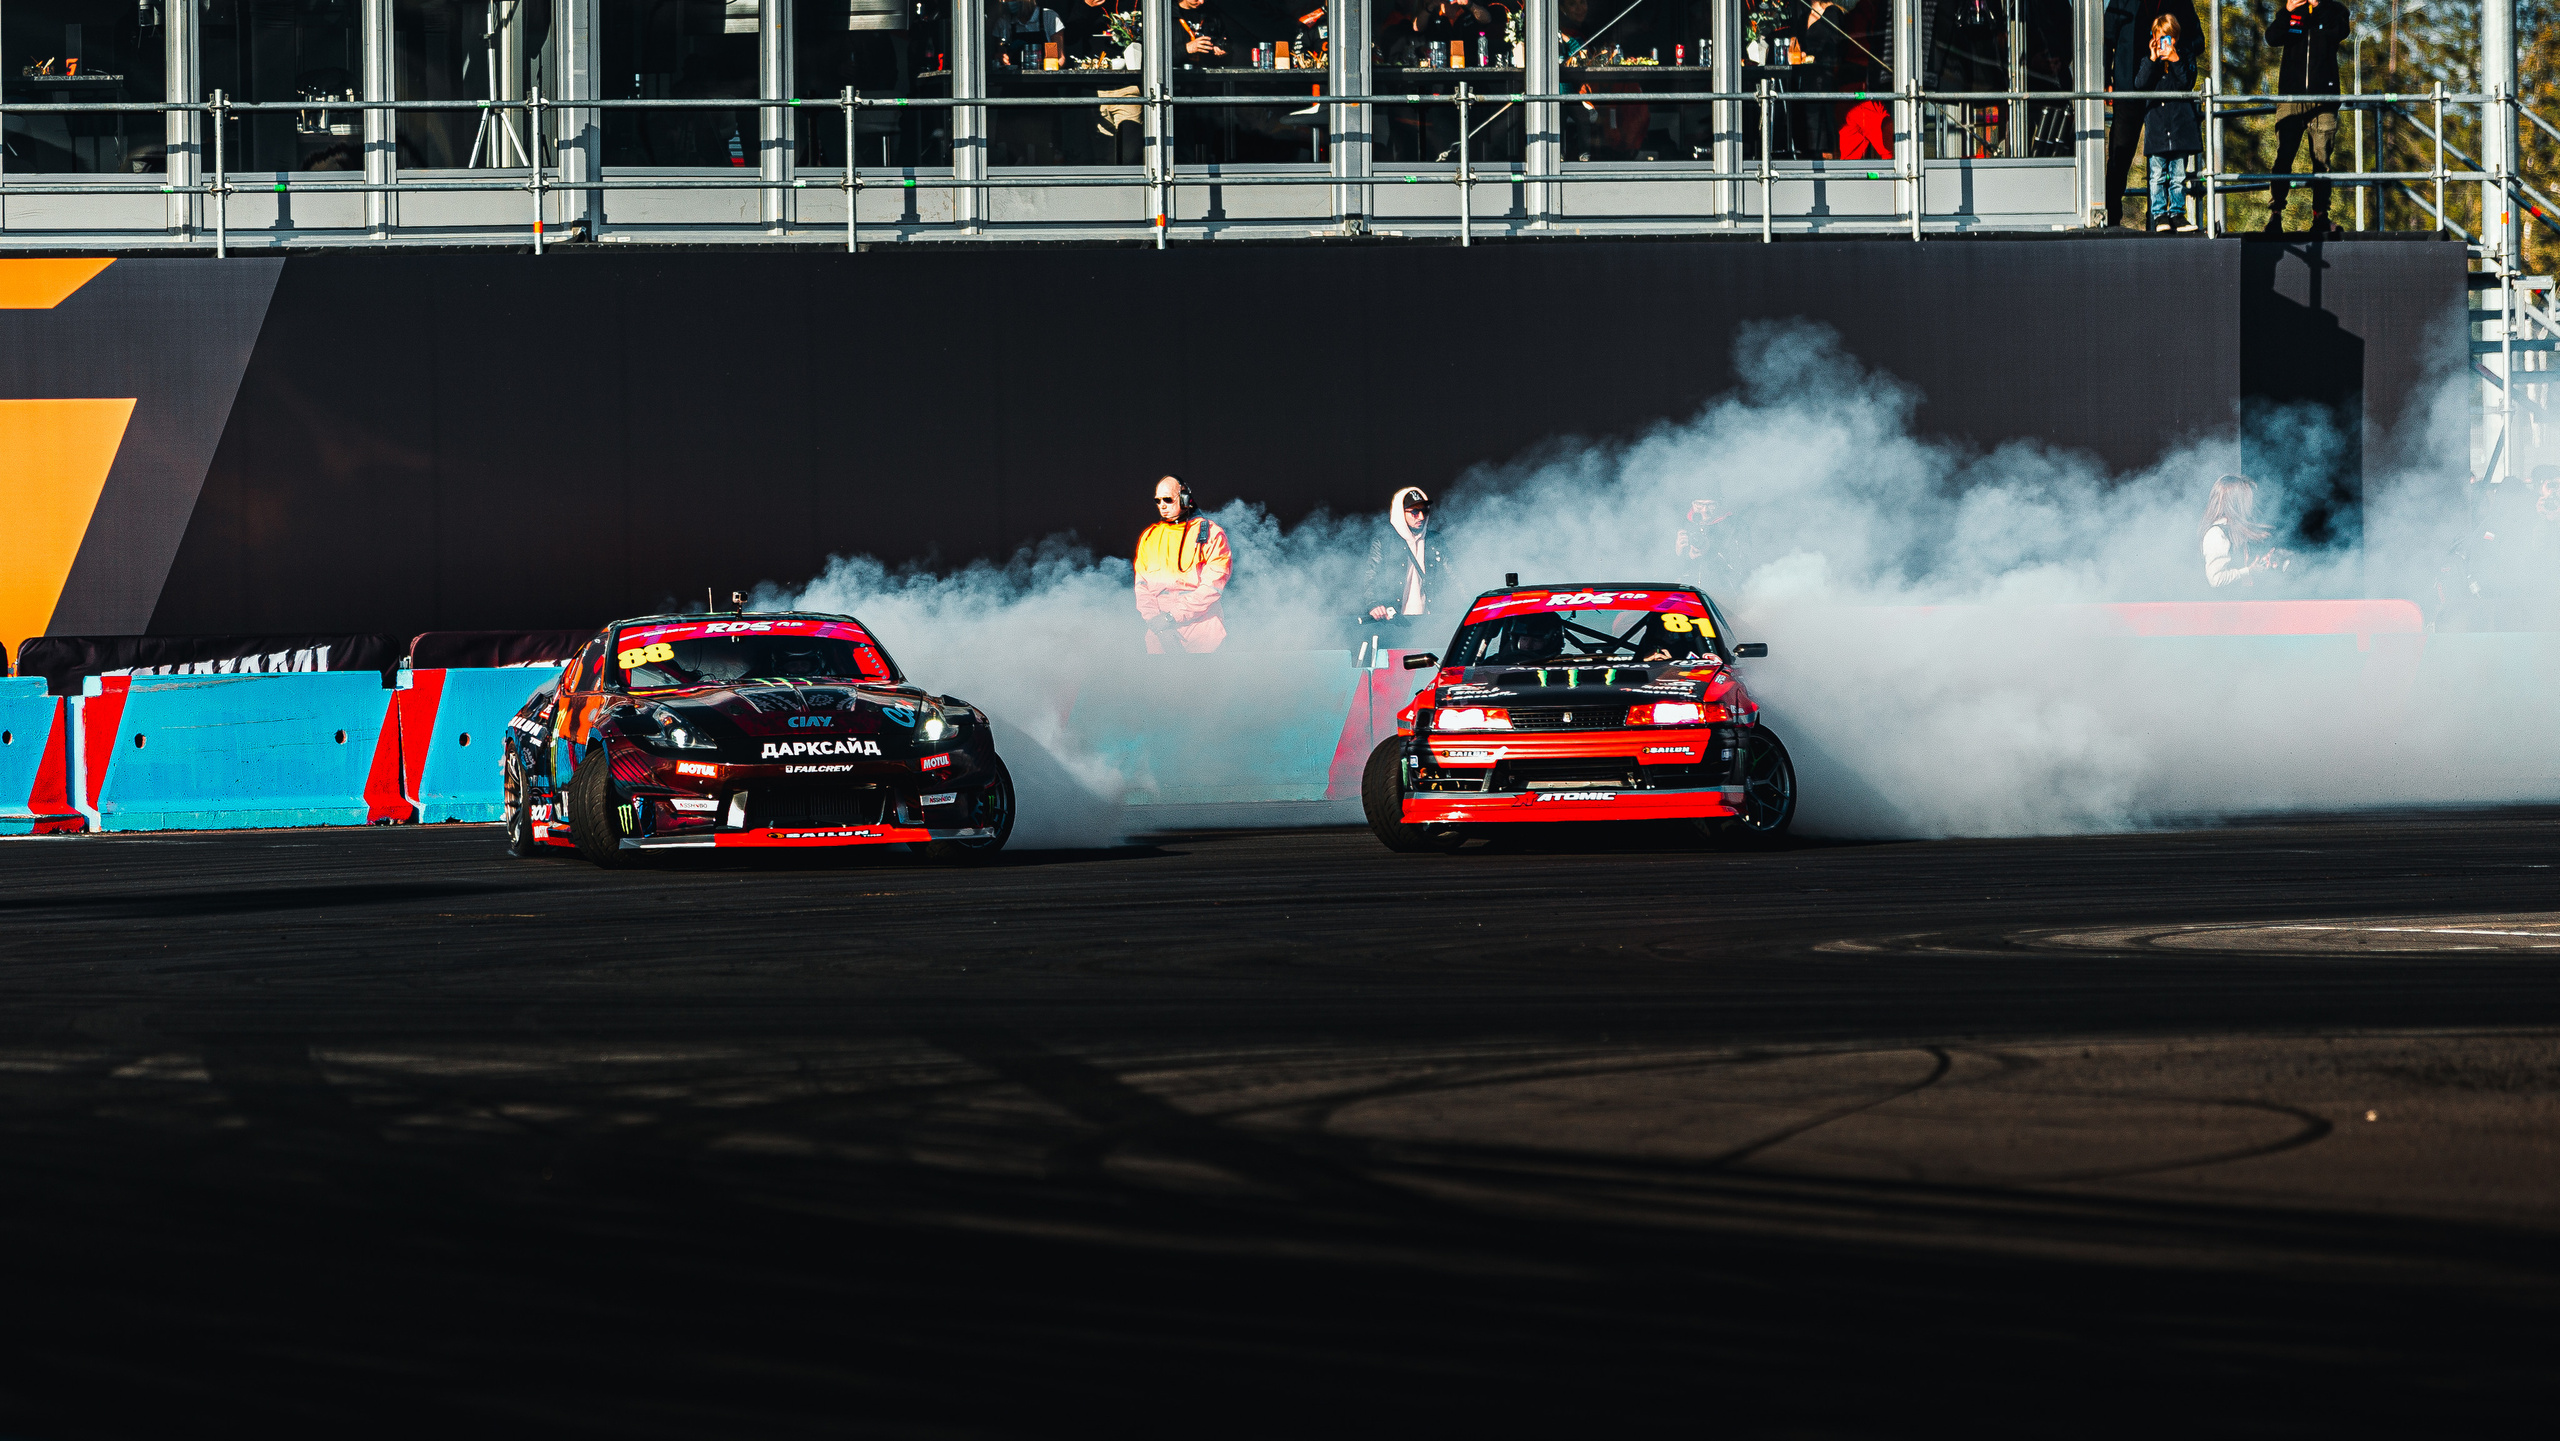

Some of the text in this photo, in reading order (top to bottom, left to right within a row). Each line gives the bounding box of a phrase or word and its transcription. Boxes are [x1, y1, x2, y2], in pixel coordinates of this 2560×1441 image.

[1546, 592, 1619, 606] RDS
[1619, 592, 1649, 600] GP
[704, 621, 775, 634] RDS
[1660, 612, 1717, 638] 81
[617, 642, 675, 670] 88
[761, 737, 882, 759] ДАРКСАЙД
[1649, 746, 1690, 754] SAILUN
[677, 762, 716, 777] MOTUL
[793, 764, 854, 774] FAILCREW
[923, 755, 949, 770] MOTUL
[1536, 792, 1617, 802] ATOMIC
[785, 829, 869, 839] SAILUN
